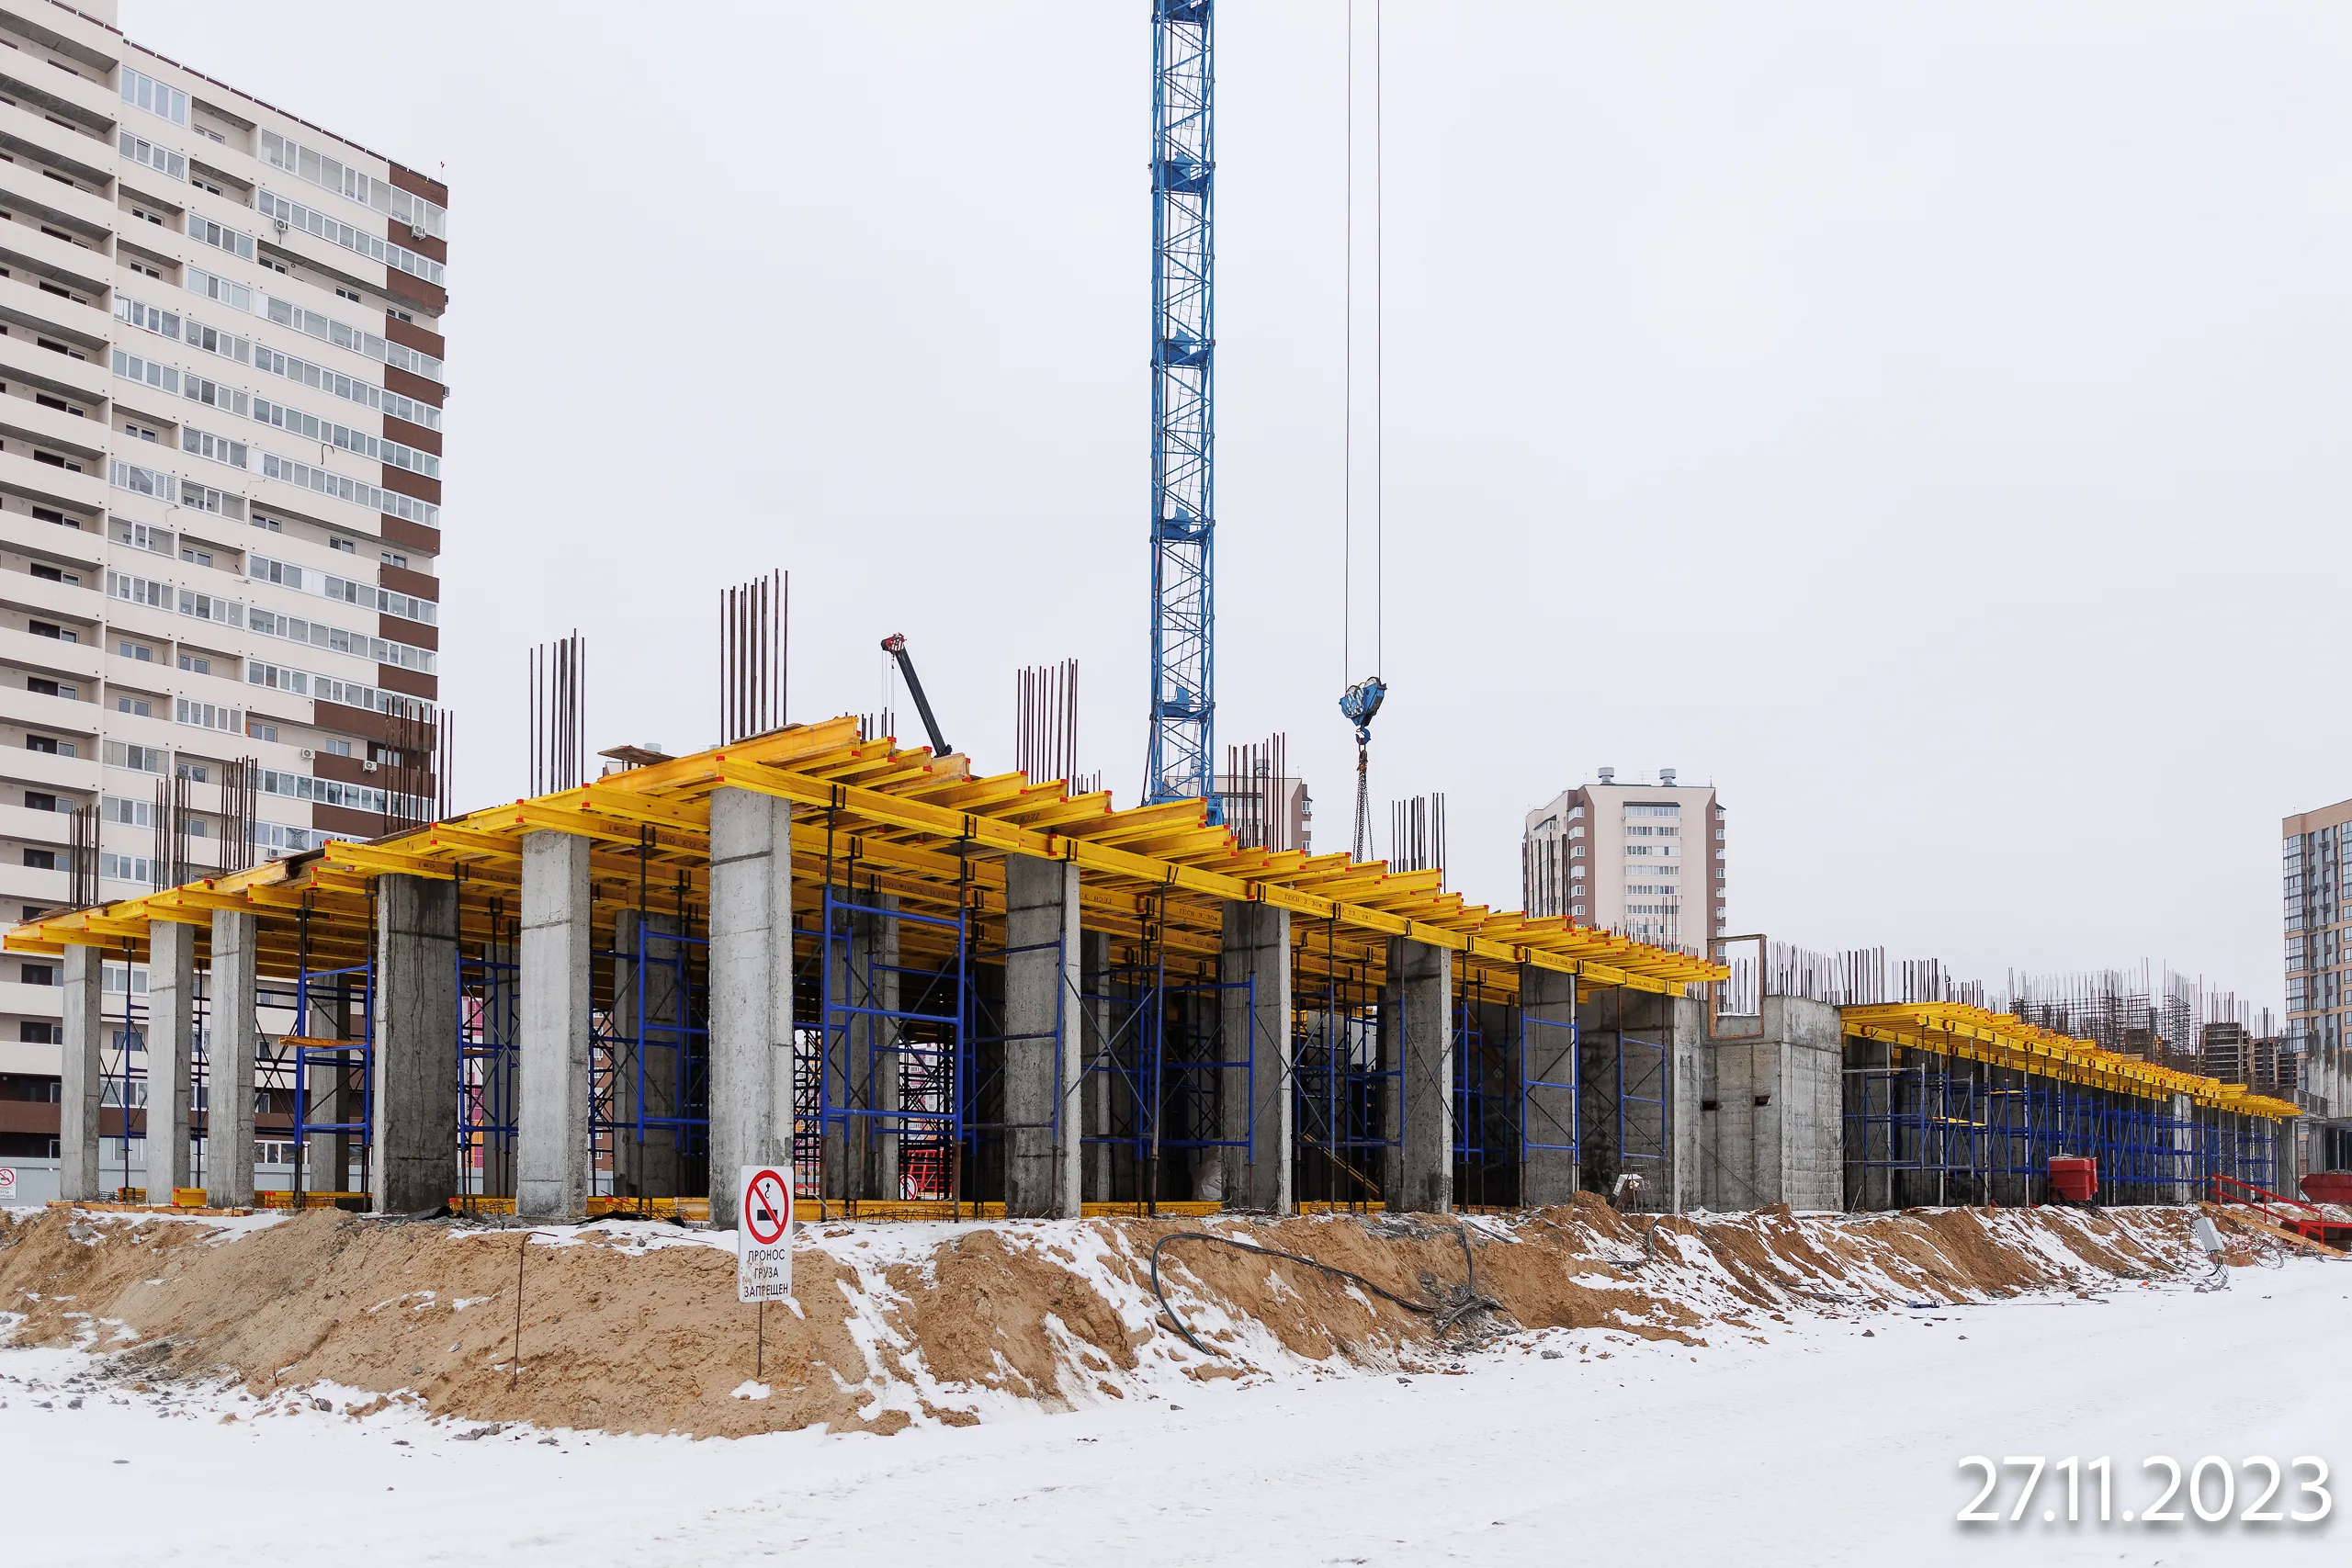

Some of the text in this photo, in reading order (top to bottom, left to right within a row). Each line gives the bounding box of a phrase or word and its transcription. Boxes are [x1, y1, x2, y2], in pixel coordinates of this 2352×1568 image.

[1283, 894, 1300, 903] TECH
[748, 1248, 786, 1262] ПРОНОС
[754, 1268, 779, 1280] ГРУЗА
[743, 1282, 788, 1298] ЗАПРЕЩЕН
